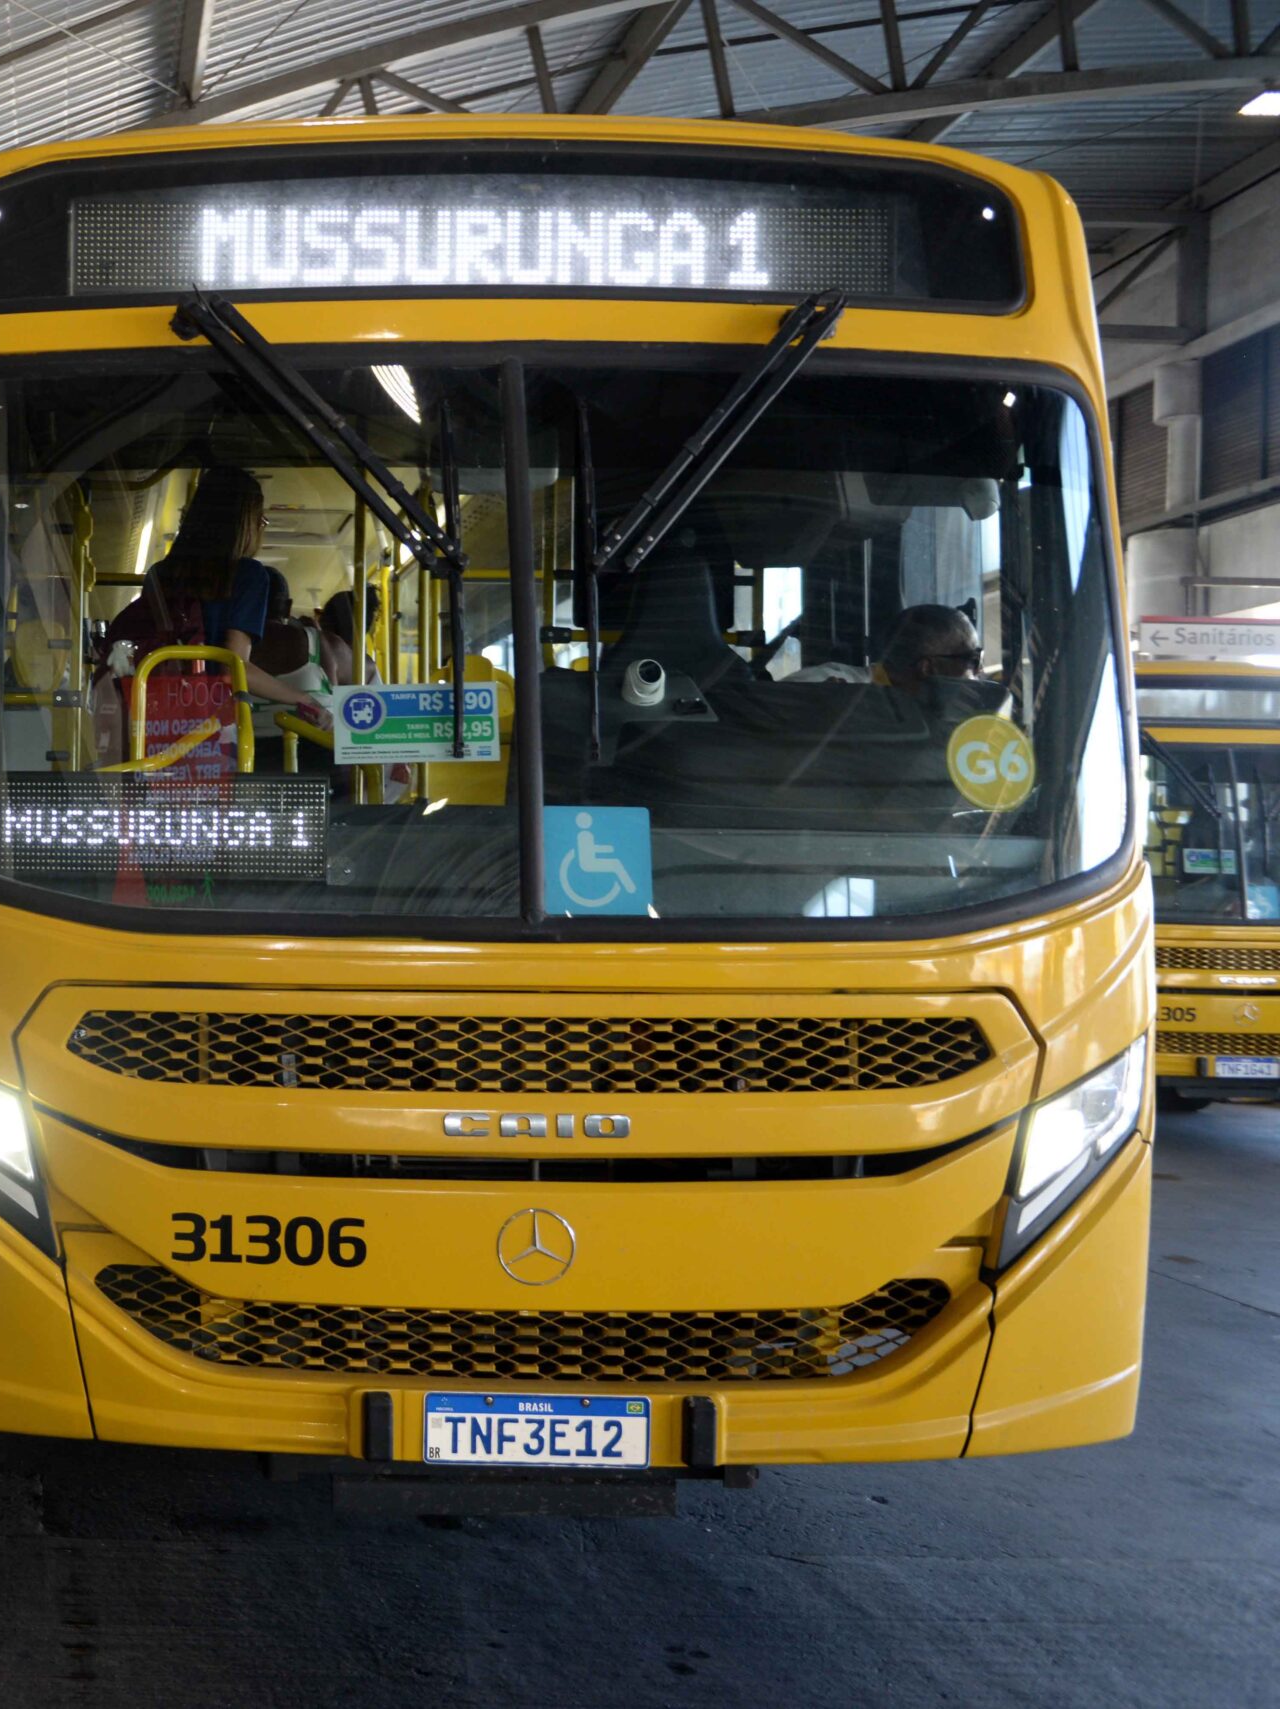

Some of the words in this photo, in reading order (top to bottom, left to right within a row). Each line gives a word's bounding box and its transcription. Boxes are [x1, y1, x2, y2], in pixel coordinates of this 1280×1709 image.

[201, 208, 706, 284] MUSSURUNGA
[729, 211, 768, 286] 1
[1175, 627, 1276, 646] Sanitários
[420, 692, 443, 712] R$
[375, 732, 407, 740] DOMINGO
[406, 723, 431, 731] TARIFA
[433, 721, 454, 740] R$
[956, 740, 1029, 784] G6
[5, 810, 272, 846] MUSSURUNGA
[291, 811, 309, 847] 1
[443, 1112, 631, 1138] CAIO
[171, 1212, 367, 1268] 31306
[518, 1402, 554, 1413] BRASIL
[444, 1416, 623, 1458] TNF3E12
[429, 1447, 441, 1459] BR
